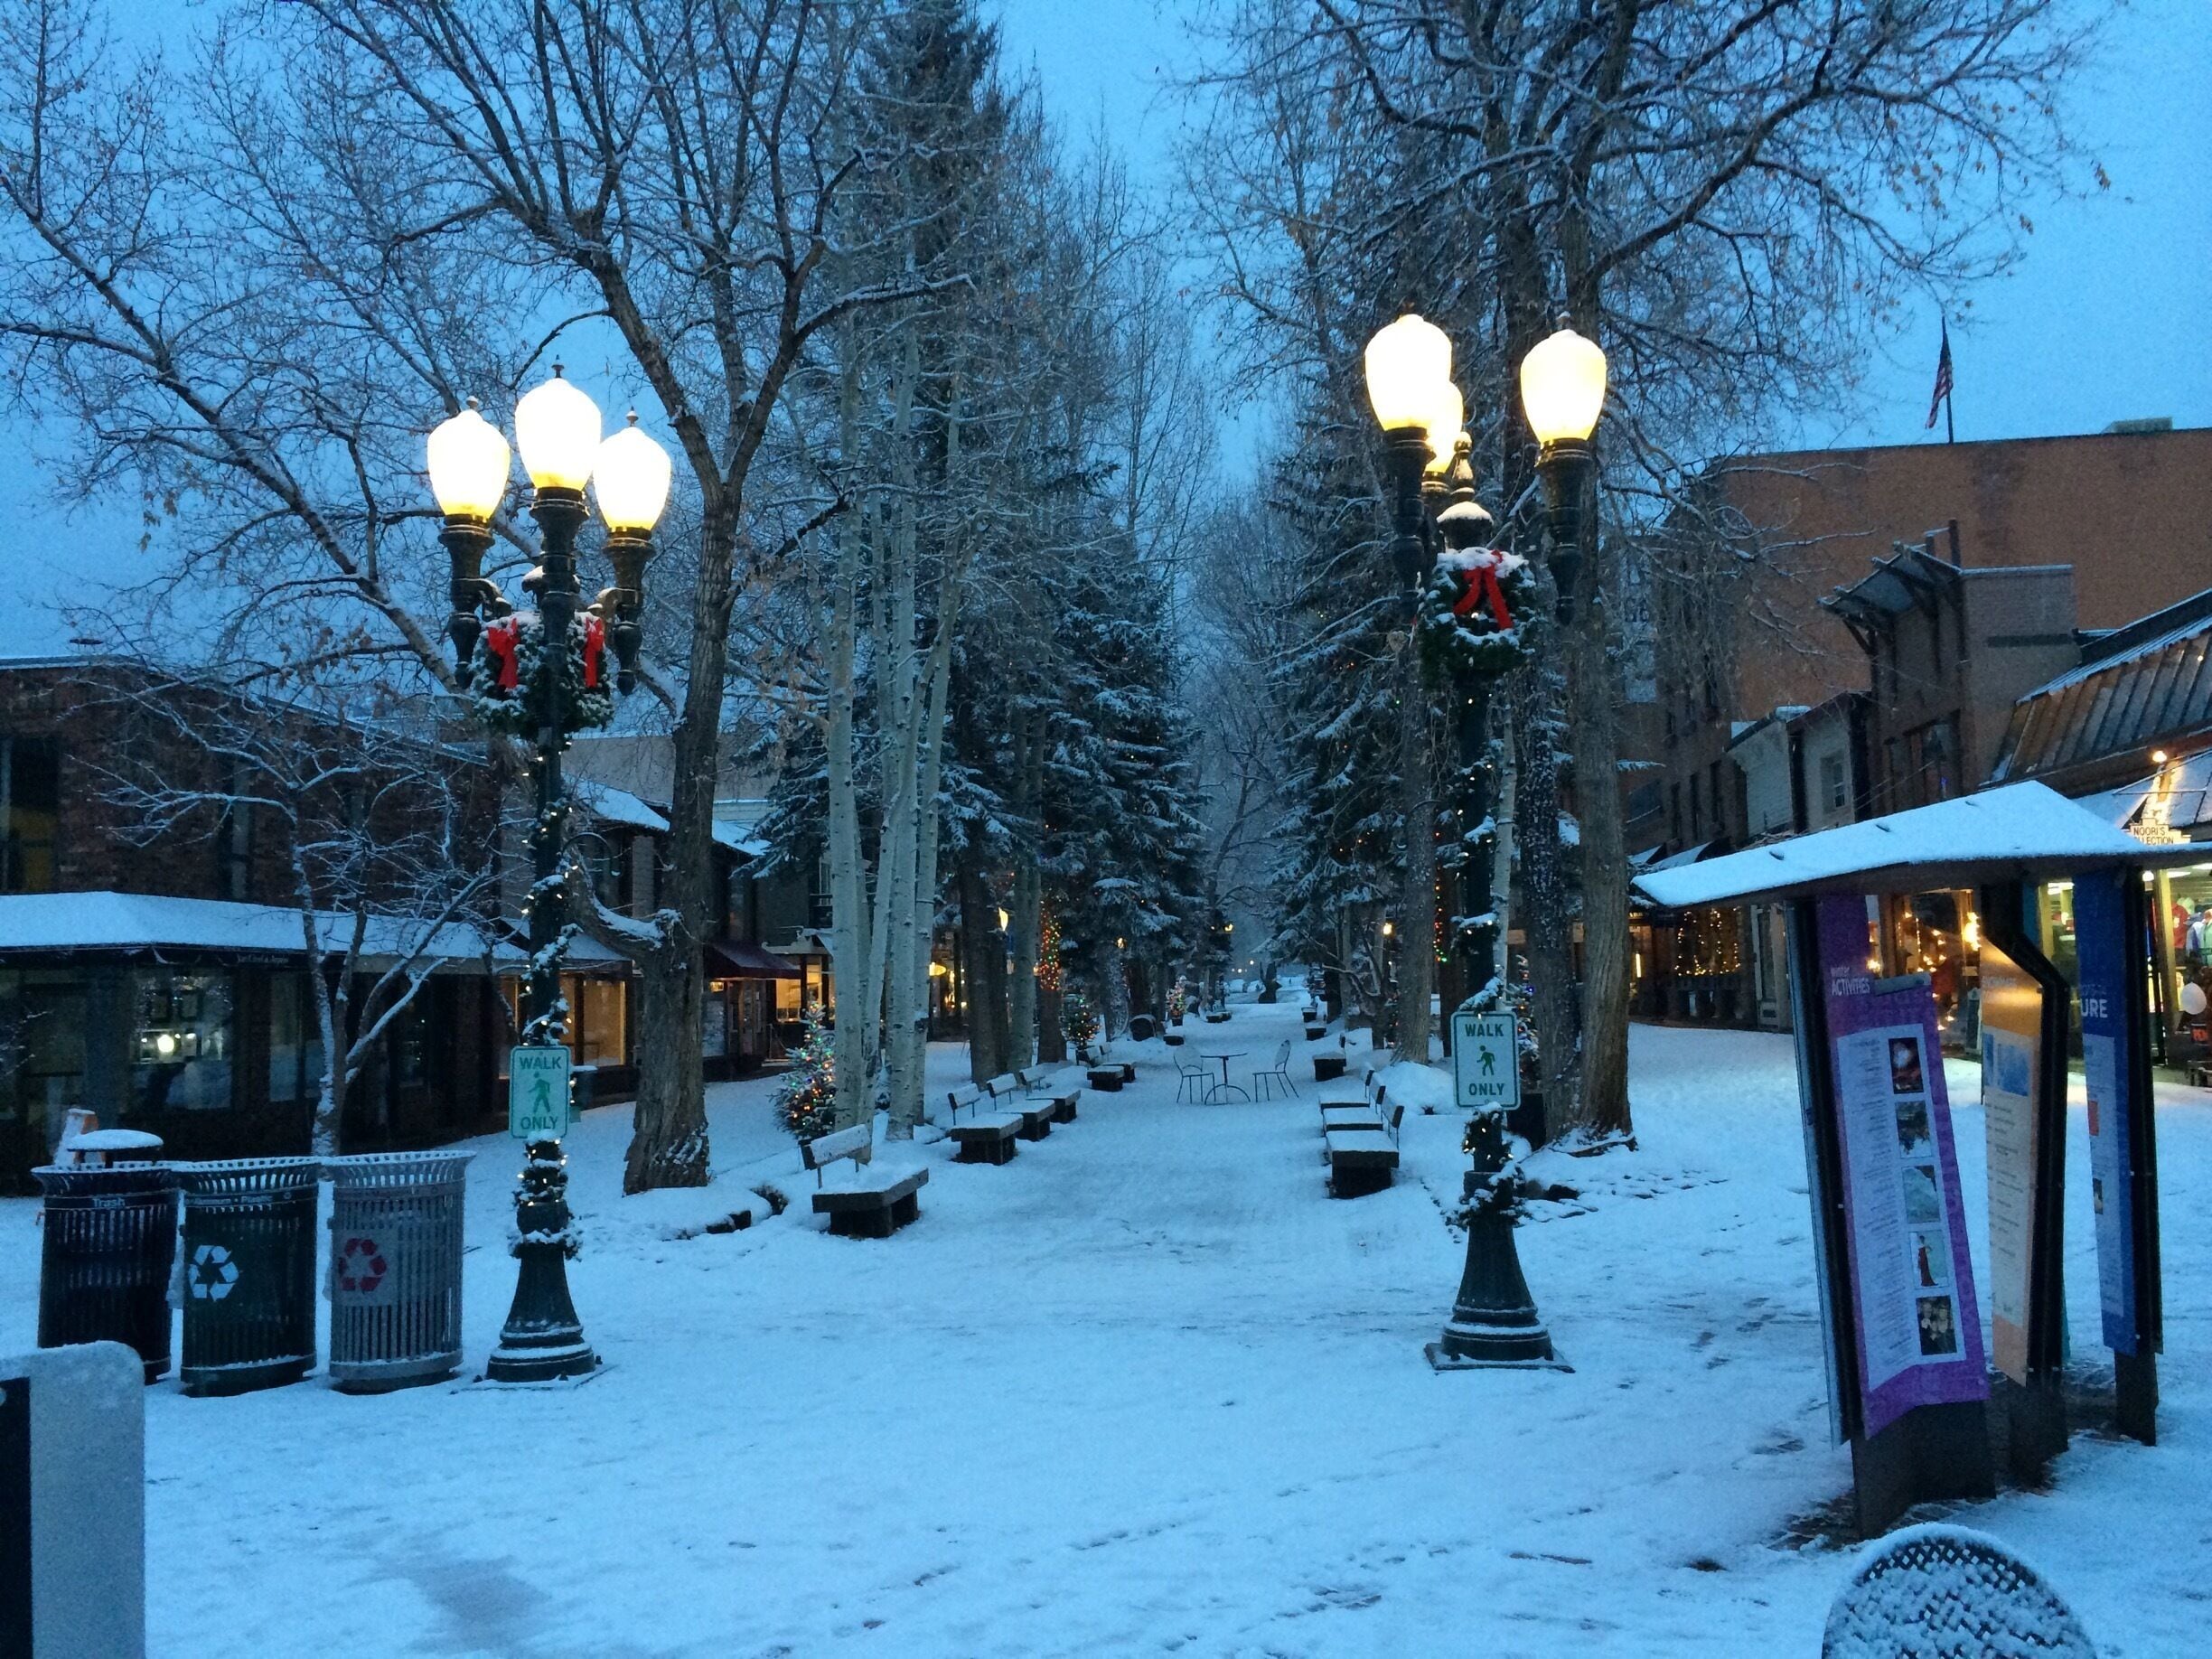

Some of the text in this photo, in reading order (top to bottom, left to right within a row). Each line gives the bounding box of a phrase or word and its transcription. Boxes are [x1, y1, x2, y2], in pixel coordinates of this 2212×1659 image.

[1832, 977, 1870, 996] ACTIVITIES
[1465, 1024, 1504, 1036] WALK
[520, 1056, 561, 1069] WALK
[1469, 1083, 1504, 1095] ONLY
[520, 1117, 558, 1129] ONLY
[92, 1196, 126, 1207] Trash
